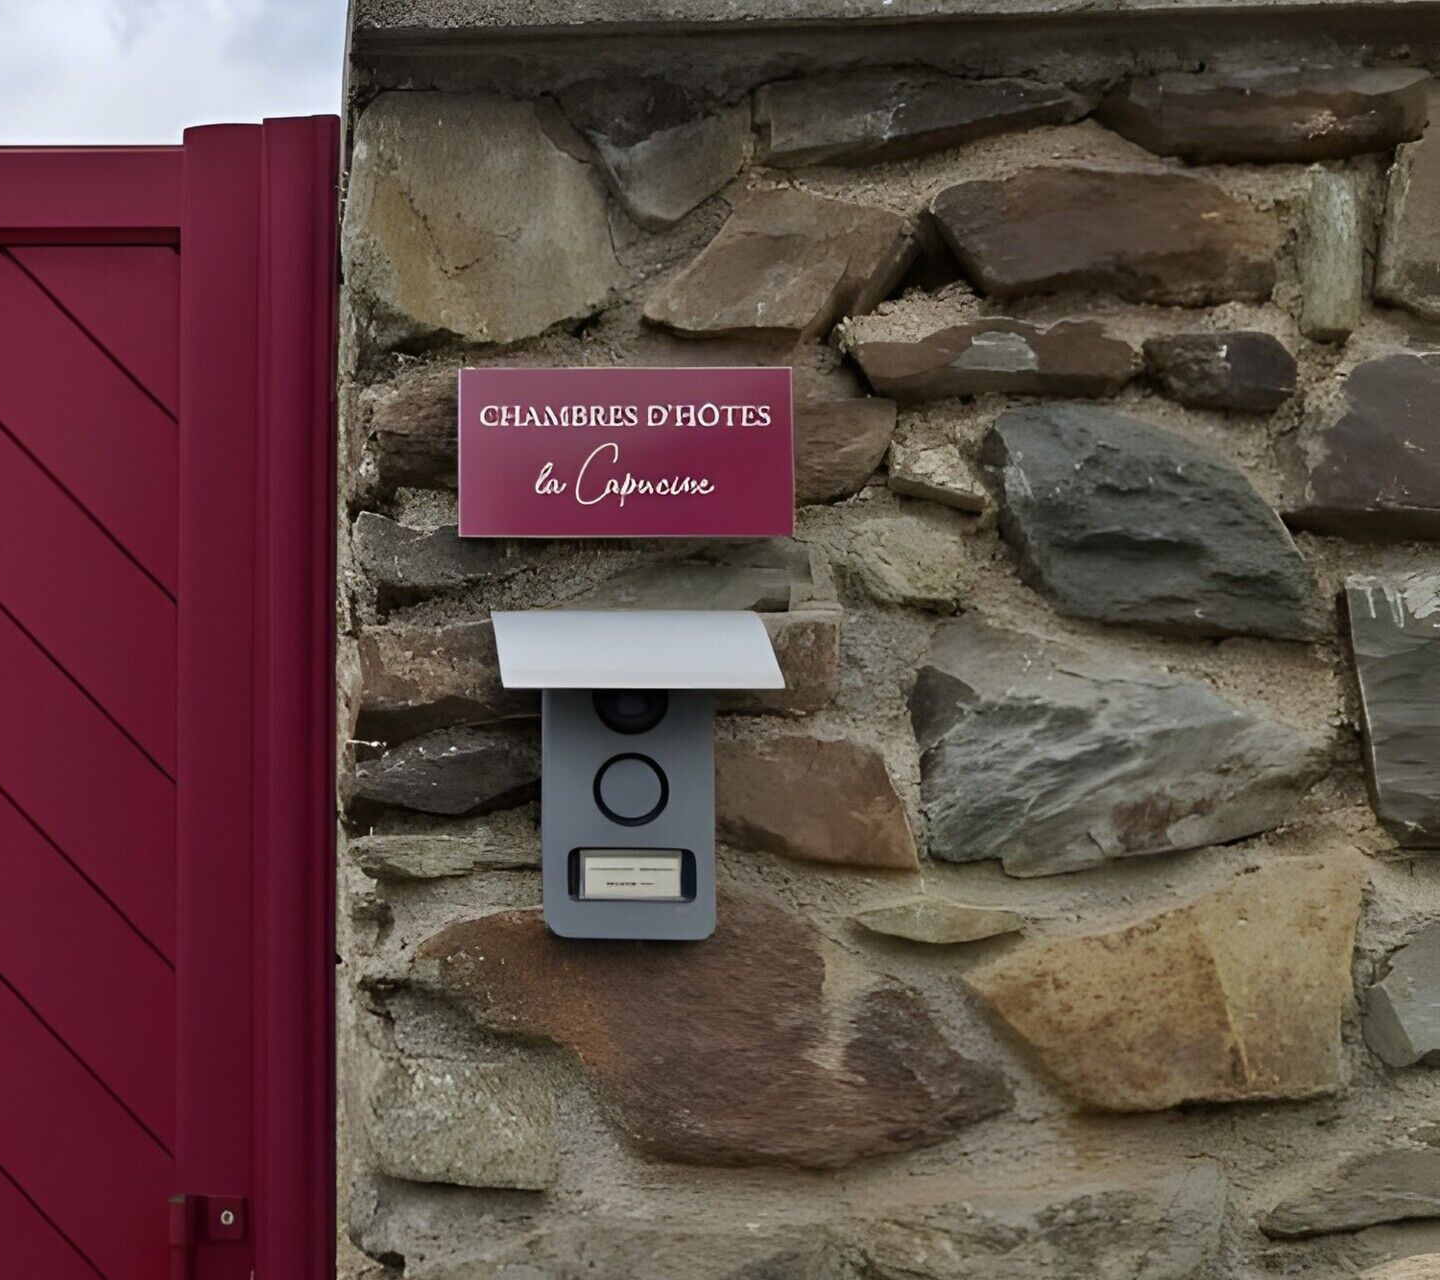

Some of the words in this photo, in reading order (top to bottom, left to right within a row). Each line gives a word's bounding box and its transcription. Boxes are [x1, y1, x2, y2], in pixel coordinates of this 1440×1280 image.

[479, 404, 639, 427] CHAMBRES
[535, 461, 567, 495] la
[575, 442, 715, 507] Capucine
